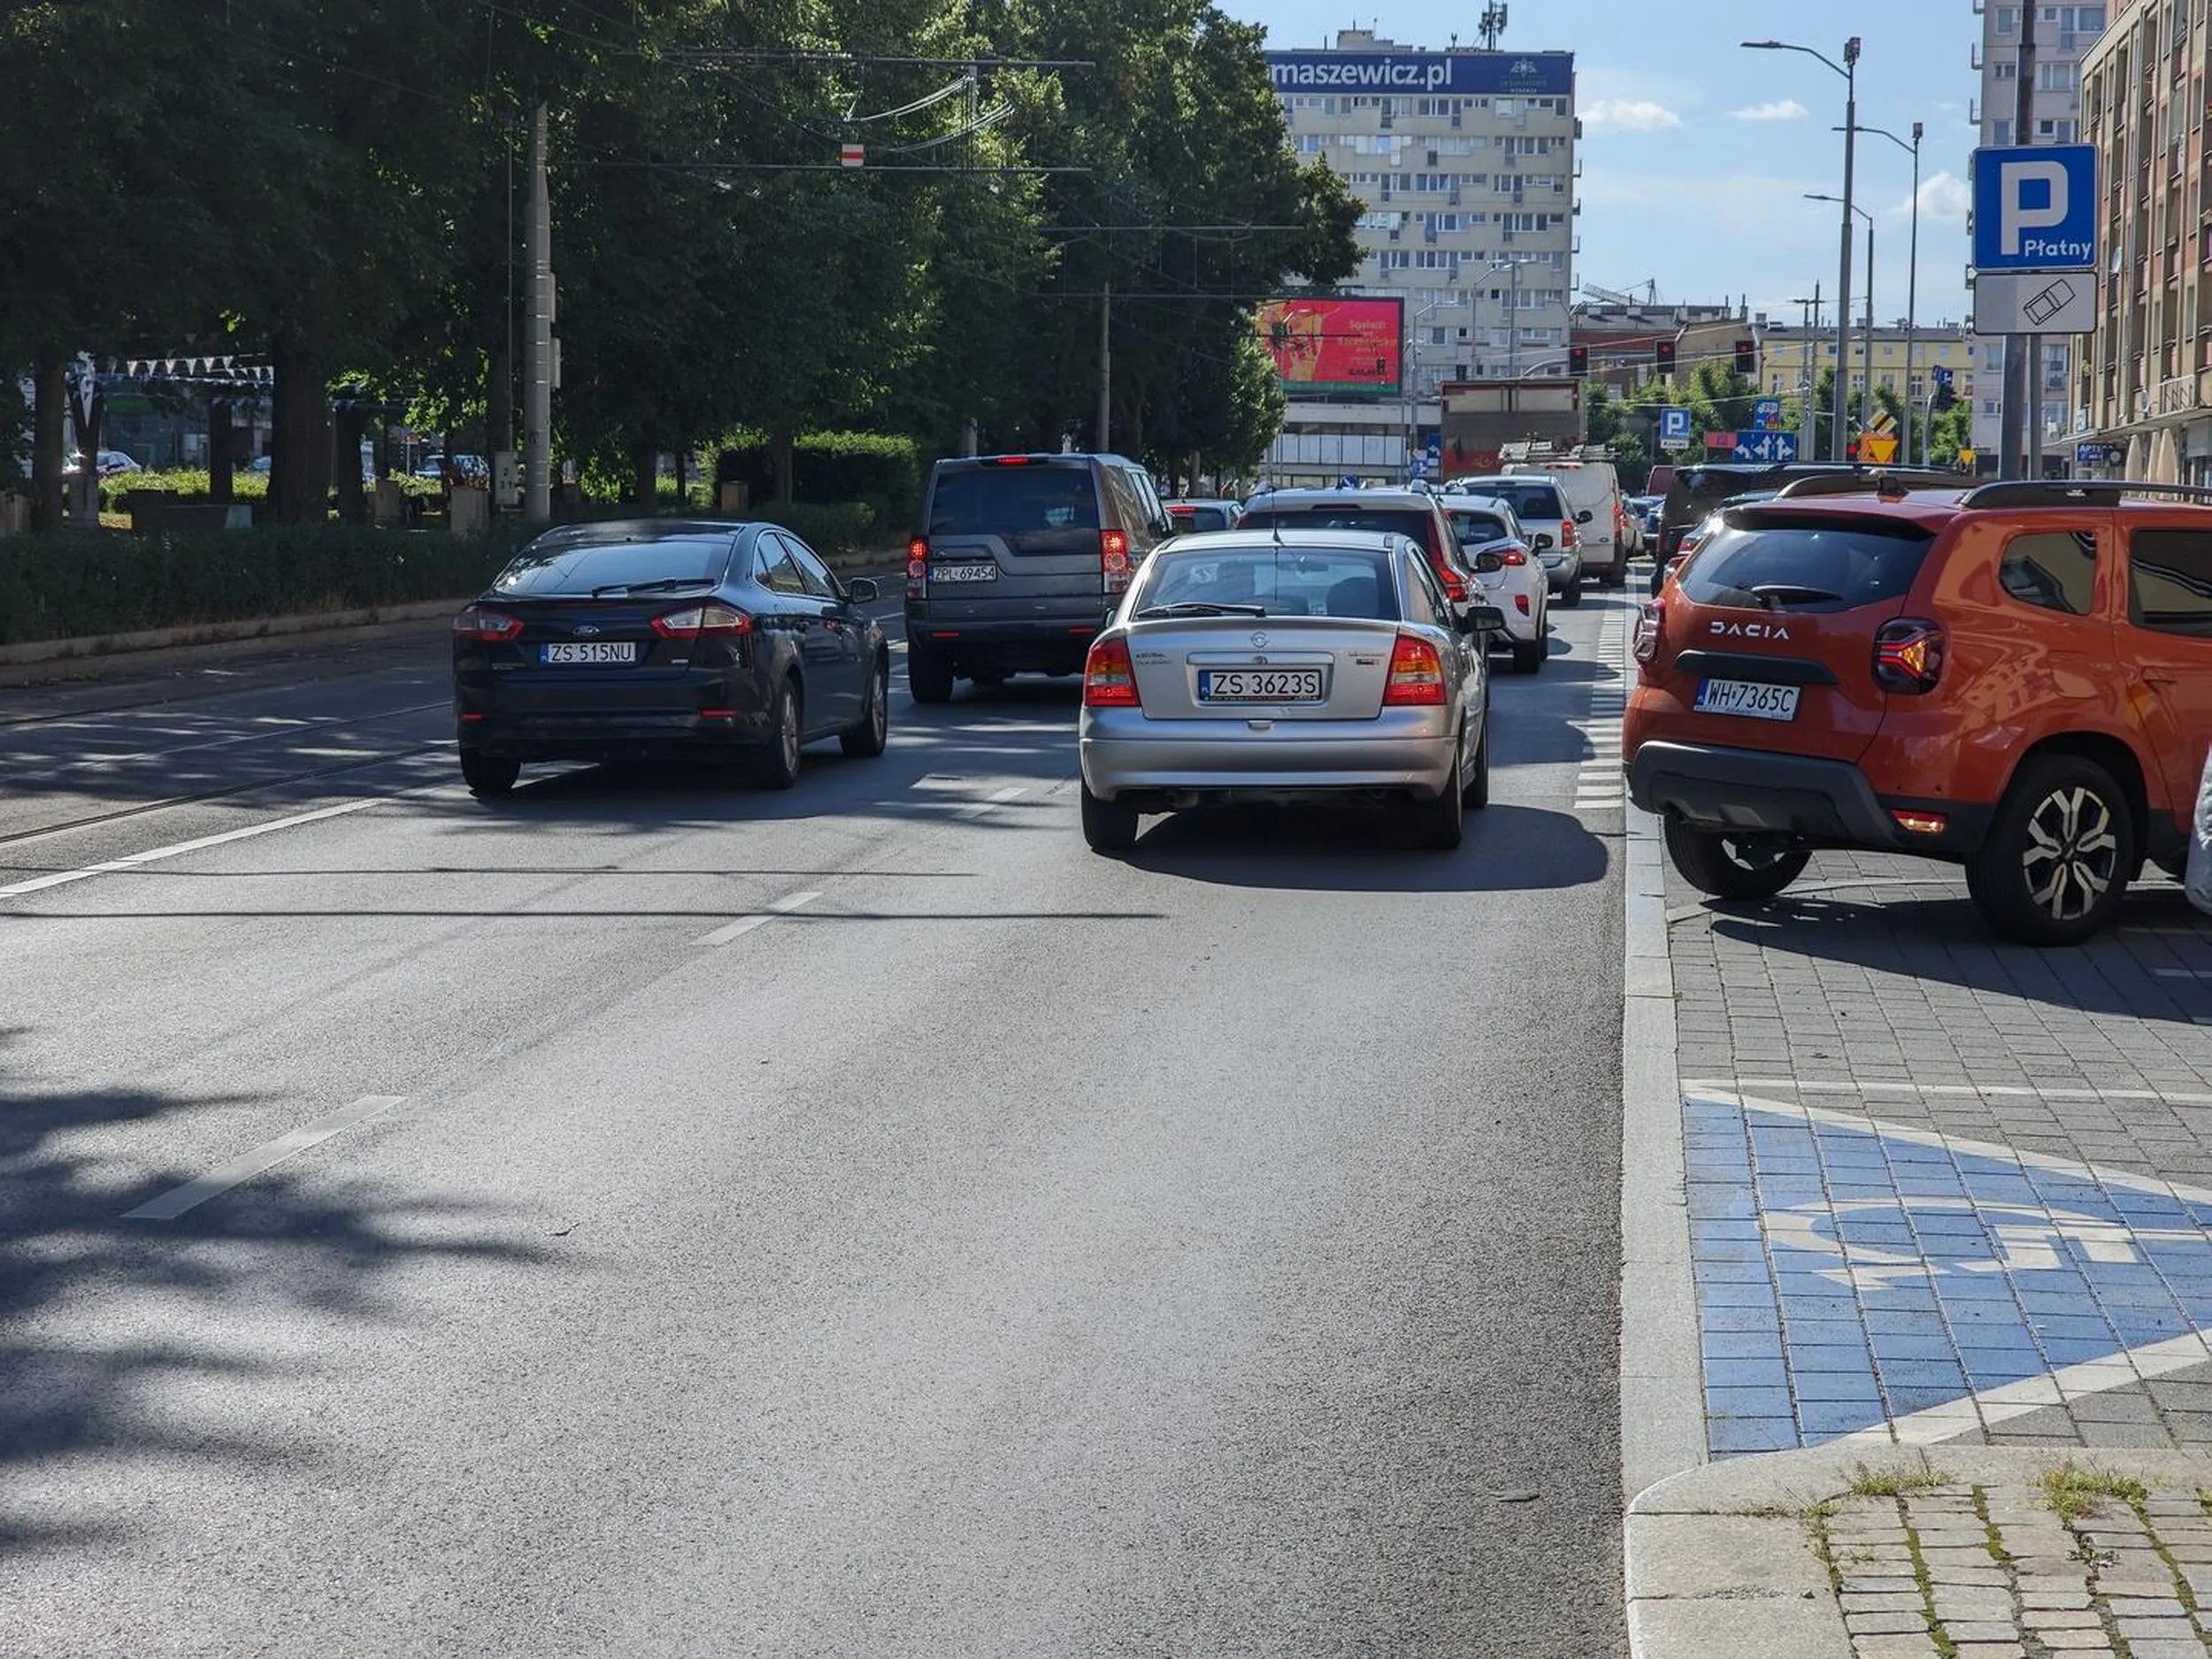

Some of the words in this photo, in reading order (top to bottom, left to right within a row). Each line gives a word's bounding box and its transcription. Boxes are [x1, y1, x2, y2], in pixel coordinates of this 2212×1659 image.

[1265, 58, 1452, 91] maszewicz.pl
[2001, 160, 2069, 256] P
[2024, 238, 2092, 261] Płatny
[1667, 412, 1684, 435] P
[935, 567, 956, 580] ZPL
[959, 566, 995, 580] 69454
[1709, 621, 1790, 640] DACIA
[551, 644, 573, 661] ZS
[580, 643, 631, 661] 515NU
[1214, 674, 1243, 694] ZS
[1252, 673, 1317, 694] 3623S
[1708, 680, 1733, 706] WH
[1735, 684, 1794, 712] 7365C
